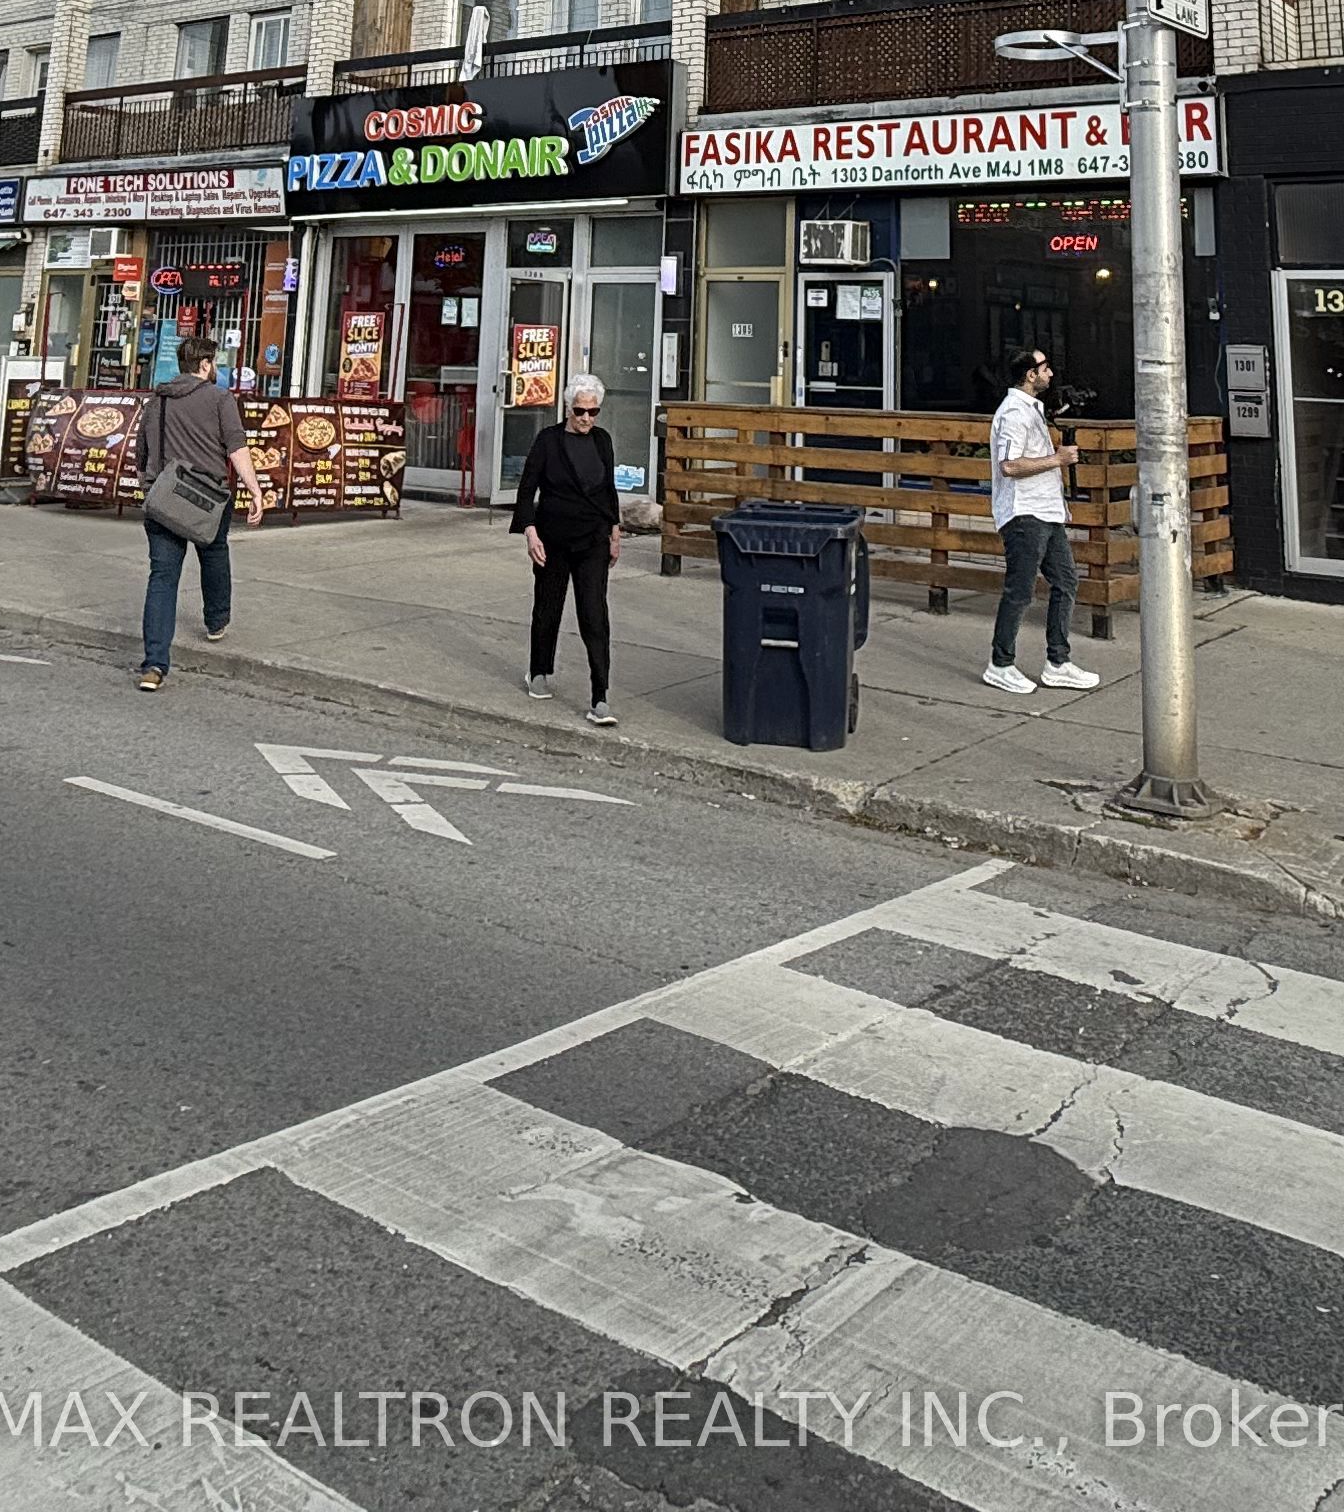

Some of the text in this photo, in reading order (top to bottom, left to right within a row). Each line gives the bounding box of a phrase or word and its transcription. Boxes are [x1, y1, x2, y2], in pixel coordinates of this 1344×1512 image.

[1175, 2, 1200, 28] LANE
[364, 102, 482, 142] COSMIC
[685, 129, 801, 167] FASIKA
[812, 111, 1077, 161] RESTAURANT
[1085, 115, 1109, 147] &
[287, 136, 569, 192] PIZZA & DONAIR
[831, 167, 868, 183] 1303
[872, 163, 943, 182] Danforth
[949, 162, 981, 180] Ave
[987, 160, 1021, 178] M4J
[1028, 158, 1064, 176] 1M8
[69, 170, 229, 194] FONE TECH SOLUTIONS
[1050, 236, 1098, 251] OPEN
[351, 314, 377, 328] FREE
[347, 327, 379, 342] SLICE
[522, 328, 550, 343] FREE
[733, 323, 753, 336] 1305
[347, 342, 378, 354] MONTH
[518, 341, 553, 359] SLICE
[519, 359, 553, 372] MONTH
[1234, 360, 1255, 372] 1301
[1236, 406, 1259, 418] 1299
